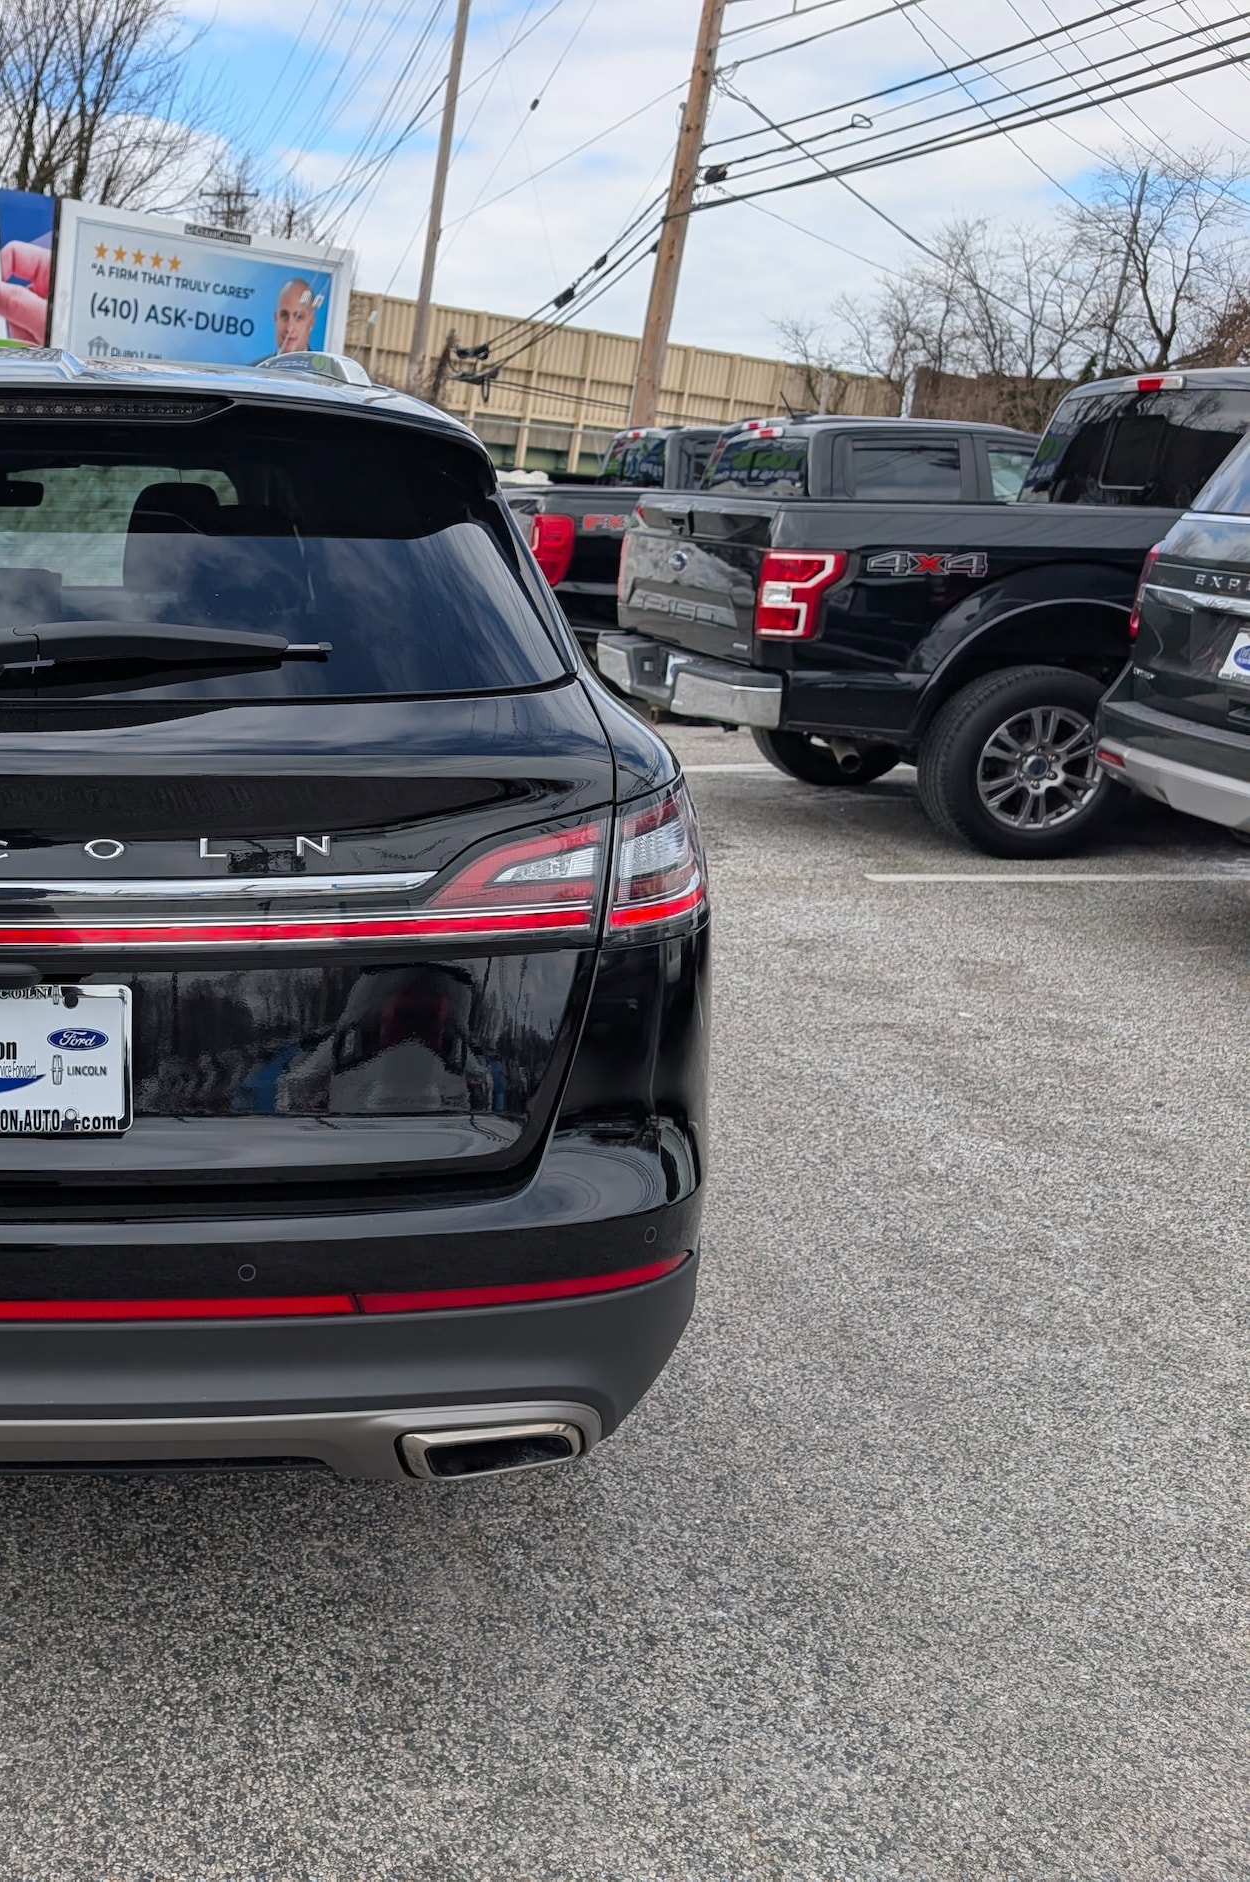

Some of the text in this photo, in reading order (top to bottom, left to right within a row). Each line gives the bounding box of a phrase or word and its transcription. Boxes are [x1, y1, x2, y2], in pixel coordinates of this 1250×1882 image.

[108, 265, 138, 282] FIRM
[141, 271, 172, 287] THAT
[174, 275, 211, 292] TRULY
[90, 292, 255, 337] (410) ASK-DUBO
[582, 513, 632, 531] FX
[1195, 573, 1250, 592] EXP
[13, 1060, 37, 1079] Forward
[66, 1065, 107, 1077] LINCOLN
[23, 1109, 61, 1132] AUTO
